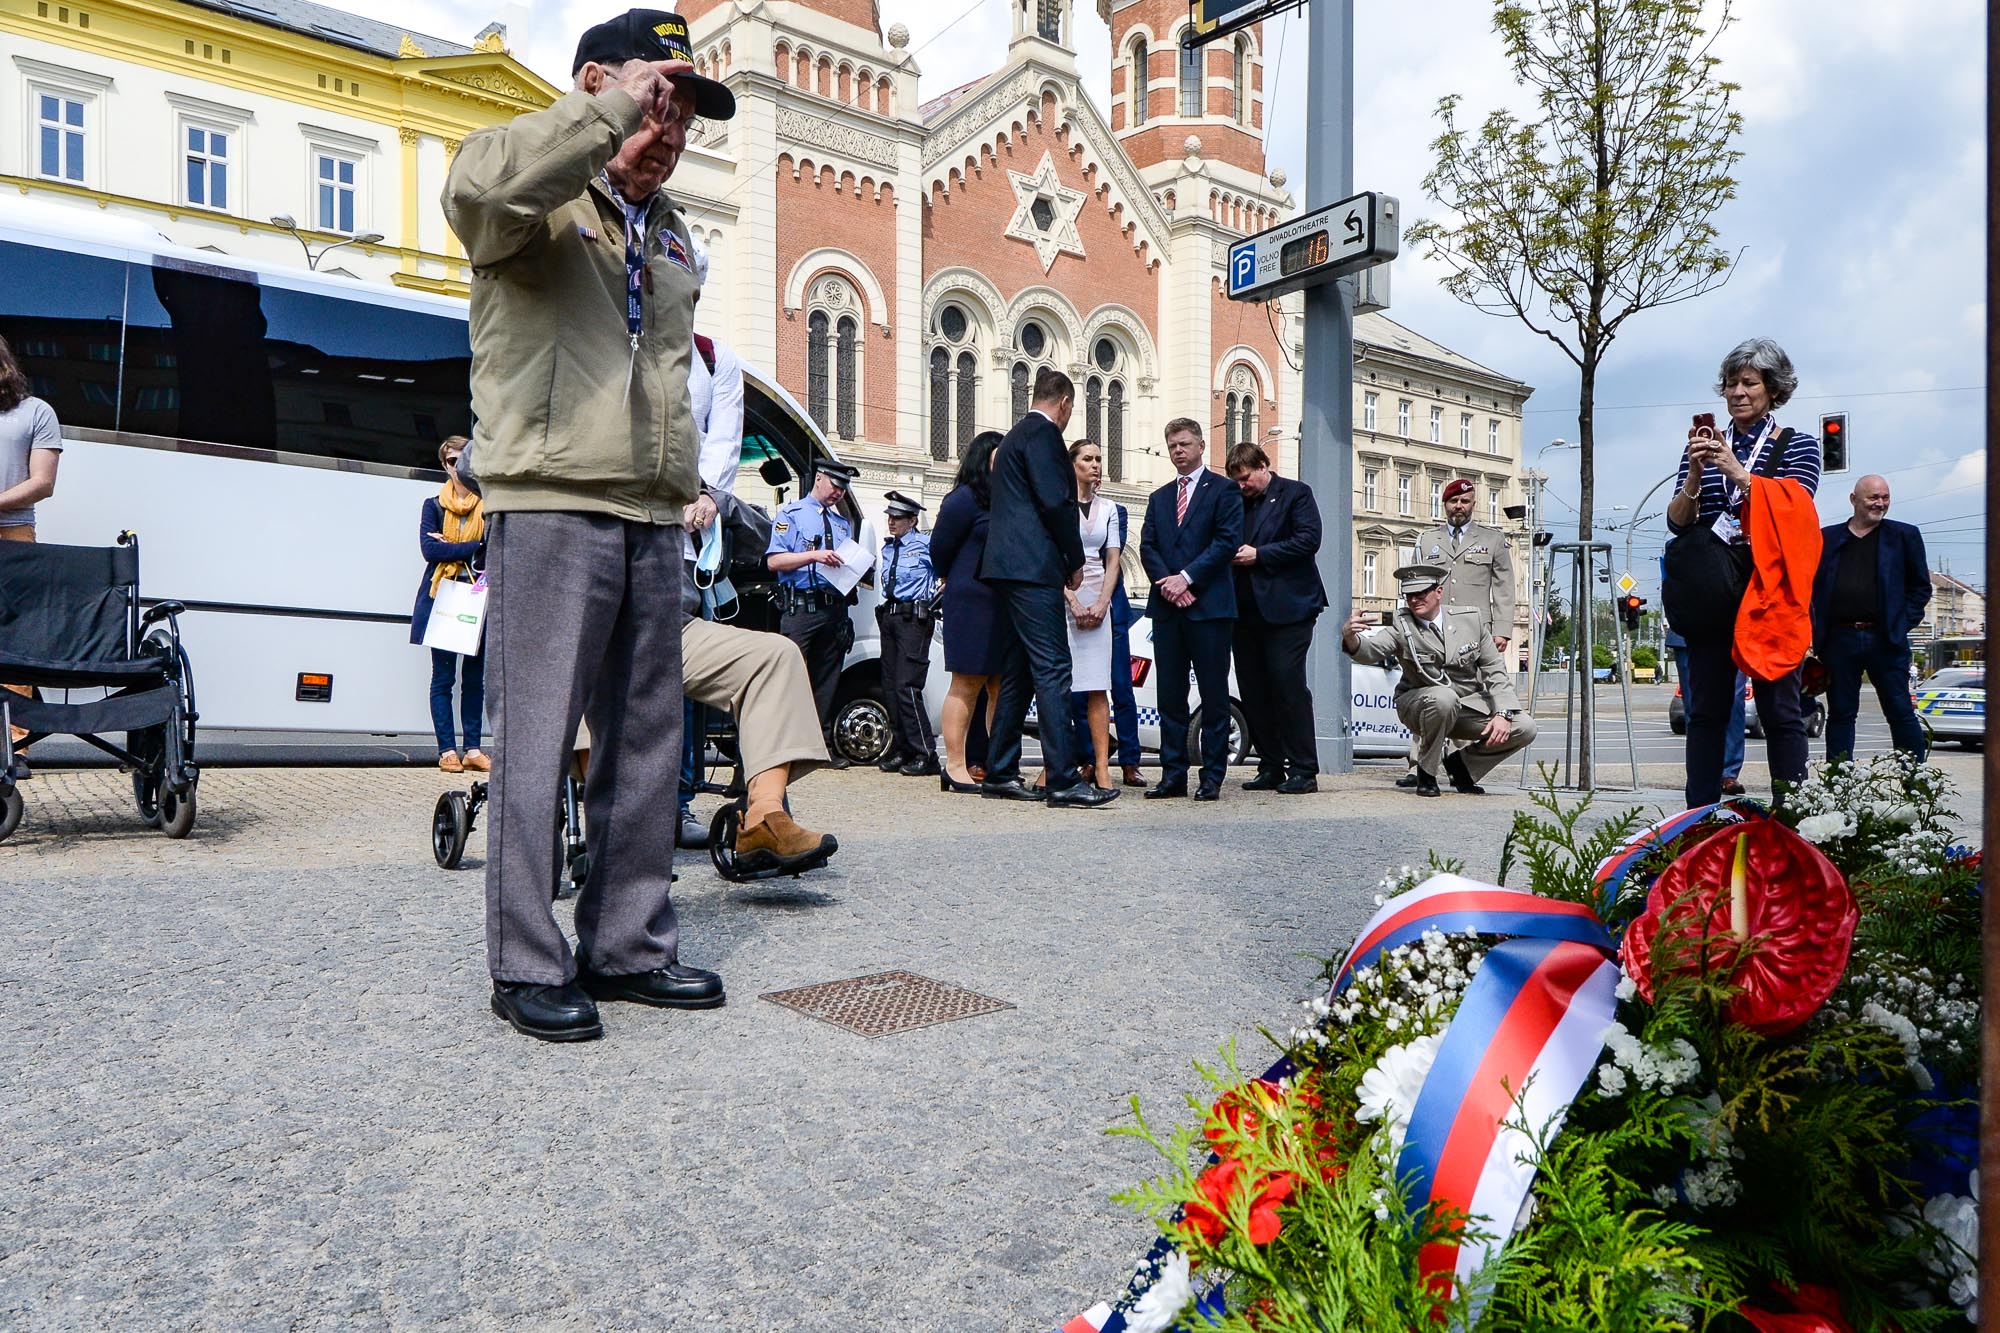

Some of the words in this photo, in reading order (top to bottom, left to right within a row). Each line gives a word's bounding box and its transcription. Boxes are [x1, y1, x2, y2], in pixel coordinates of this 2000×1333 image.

[653, 23, 685, 37] WORLD
[1269, 215, 1329, 244] DIVADLO/THEATRE
[1307, 234, 1328, 265] 16
[1256, 250, 1280, 265] VOLNO
[1238, 260, 1251, 286] P
[1259, 262, 1276, 275] FREE
[1351, 693, 1398, 709] OLICI
[1366, 723, 1398, 734] PLZEŇ
